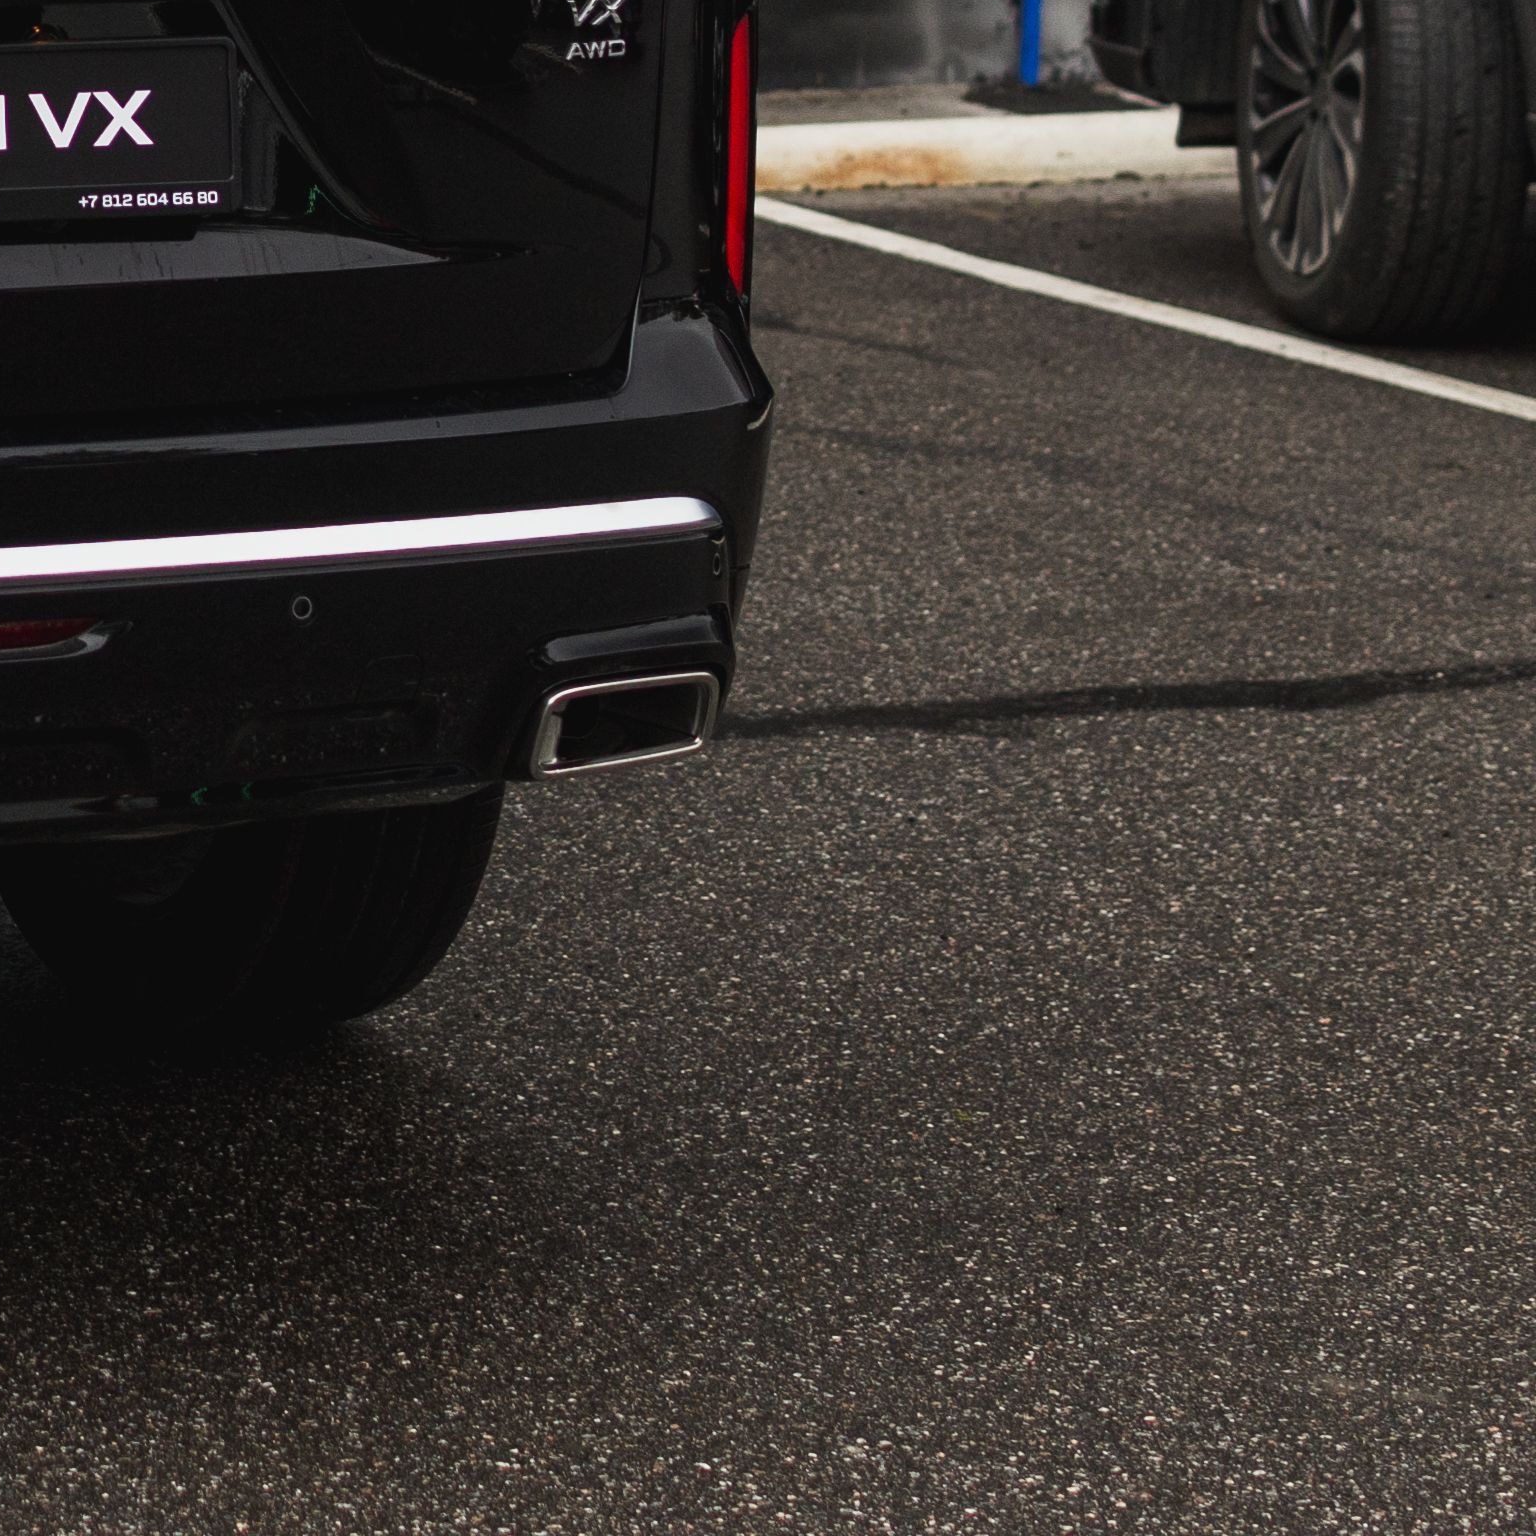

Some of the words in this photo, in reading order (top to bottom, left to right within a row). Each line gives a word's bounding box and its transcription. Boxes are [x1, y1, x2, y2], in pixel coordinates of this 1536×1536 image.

[566, 39, 626, 61] AWD
[28, 89, 154, 149] VX
[78, 194, 99, 209] +7
[102, 193, 133, 208] 812
[136, 192, 169, 207] 604
[172, 191, 194, 206] 66
[196, 190, 219, 205] 80
